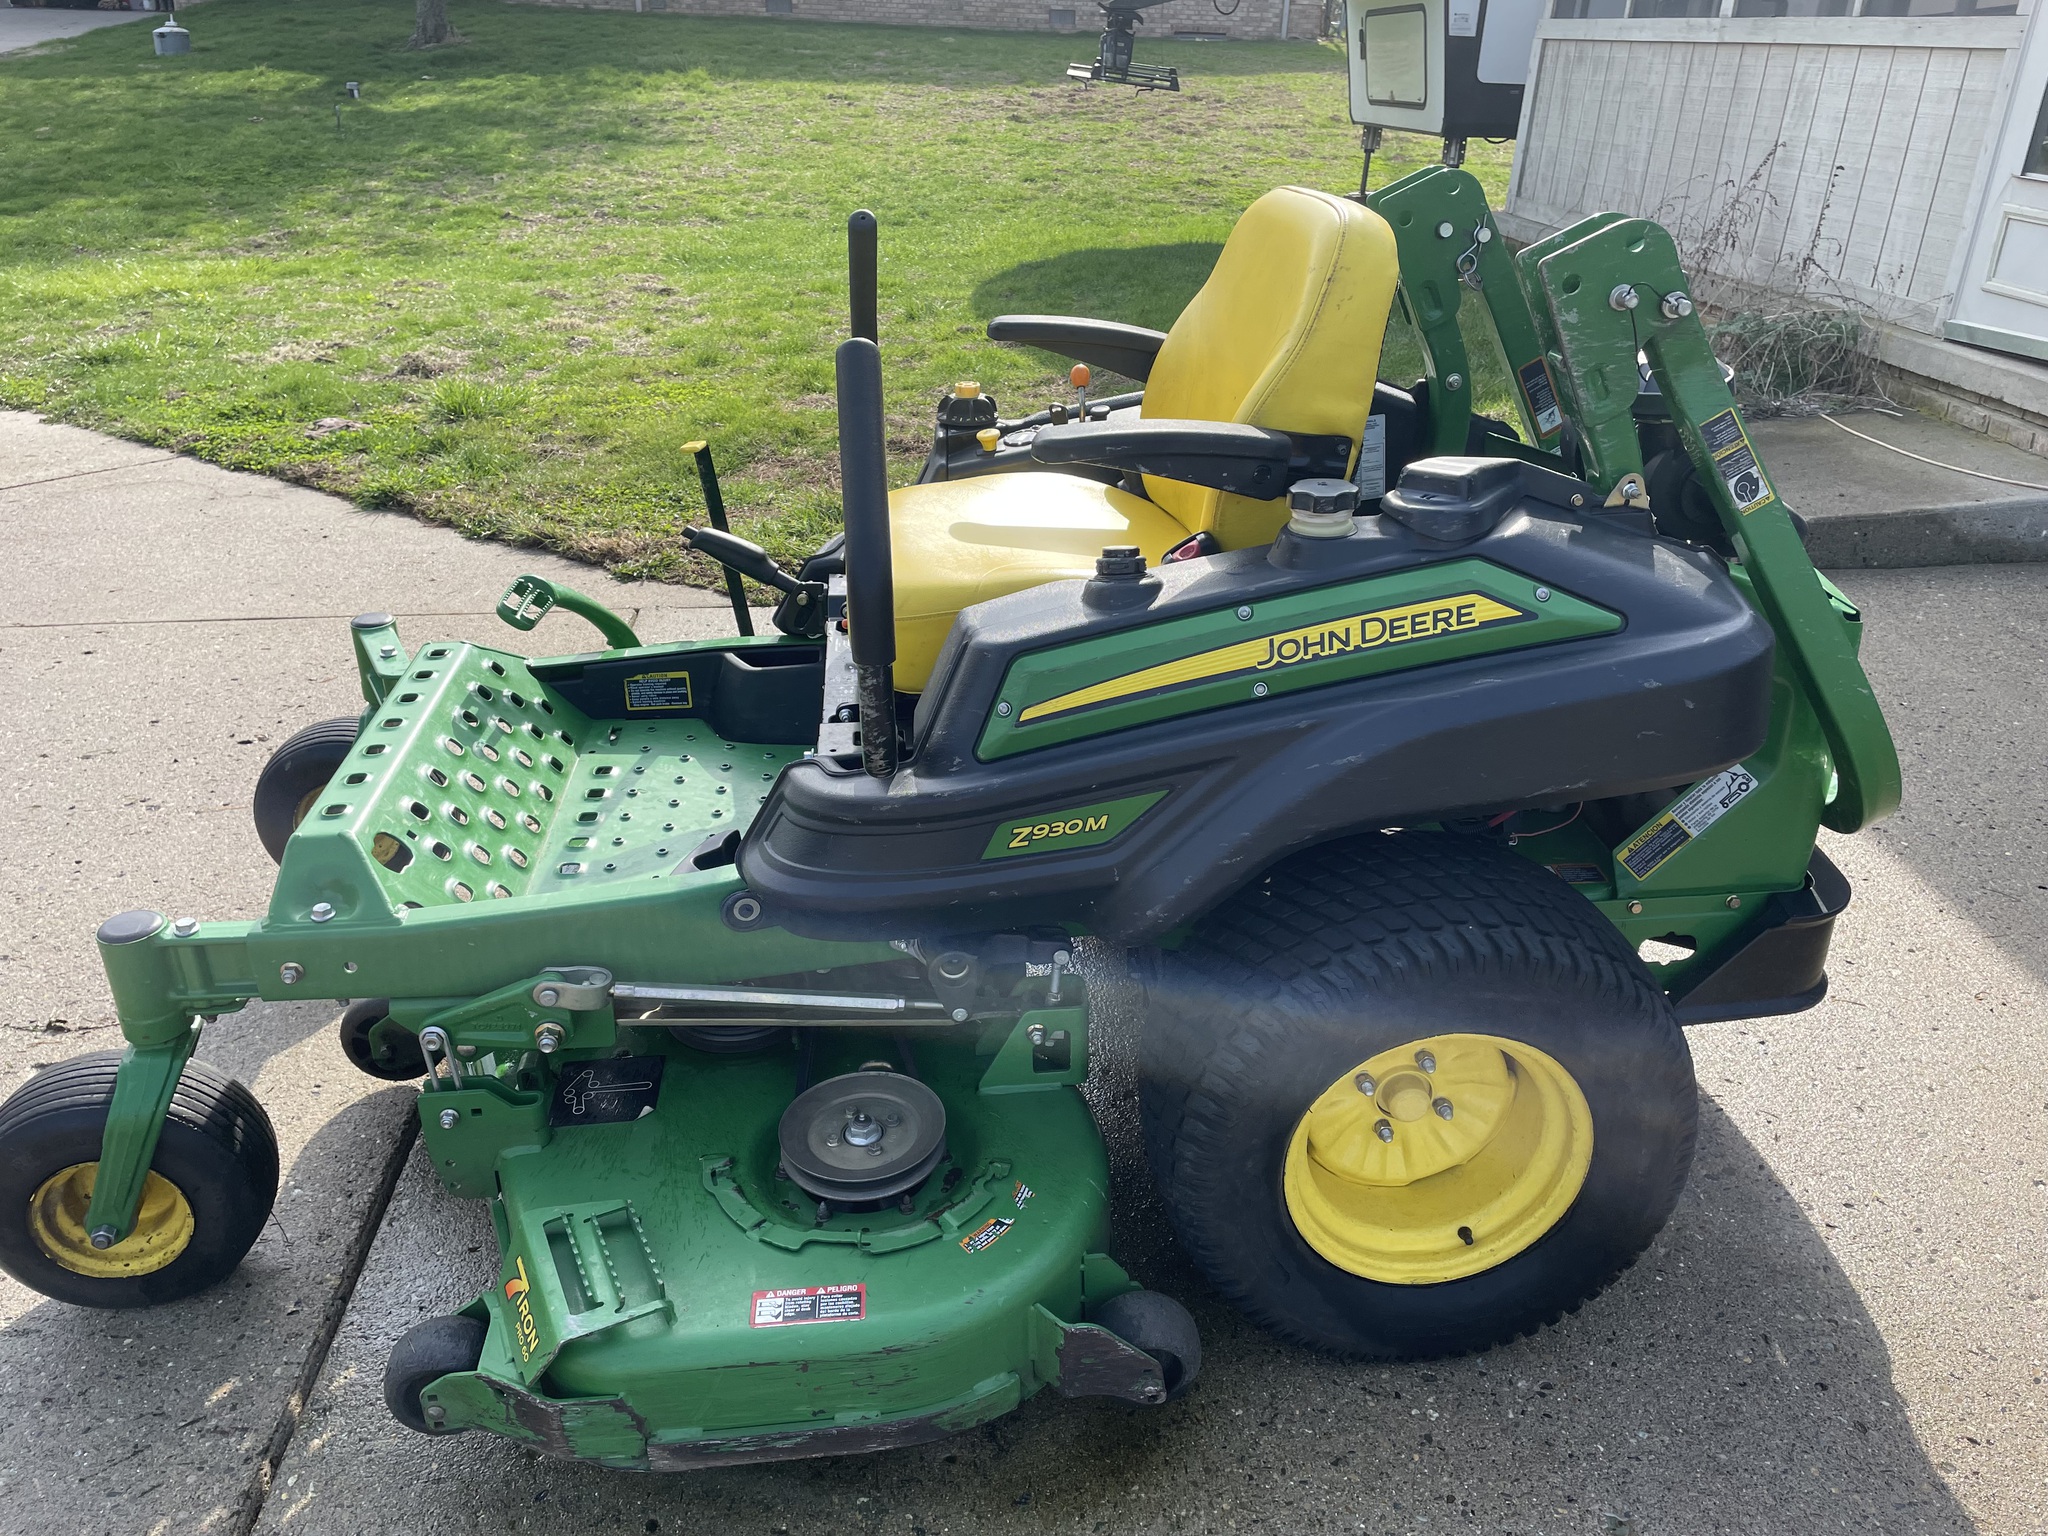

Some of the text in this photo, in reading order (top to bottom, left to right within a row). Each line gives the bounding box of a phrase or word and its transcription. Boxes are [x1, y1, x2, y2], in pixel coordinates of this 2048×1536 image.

[1740, 498, 1767, 515] CAUTION
[1256, 603, 1478, 670] JOHN DEERE
[1008, 814, 1109, 850] Z930M
[776, 1288, 807, 1297] DANGER
[827, 1284, 858, 1293] PELIGRO
[514, 1321, 529, 1362] PRO 60
